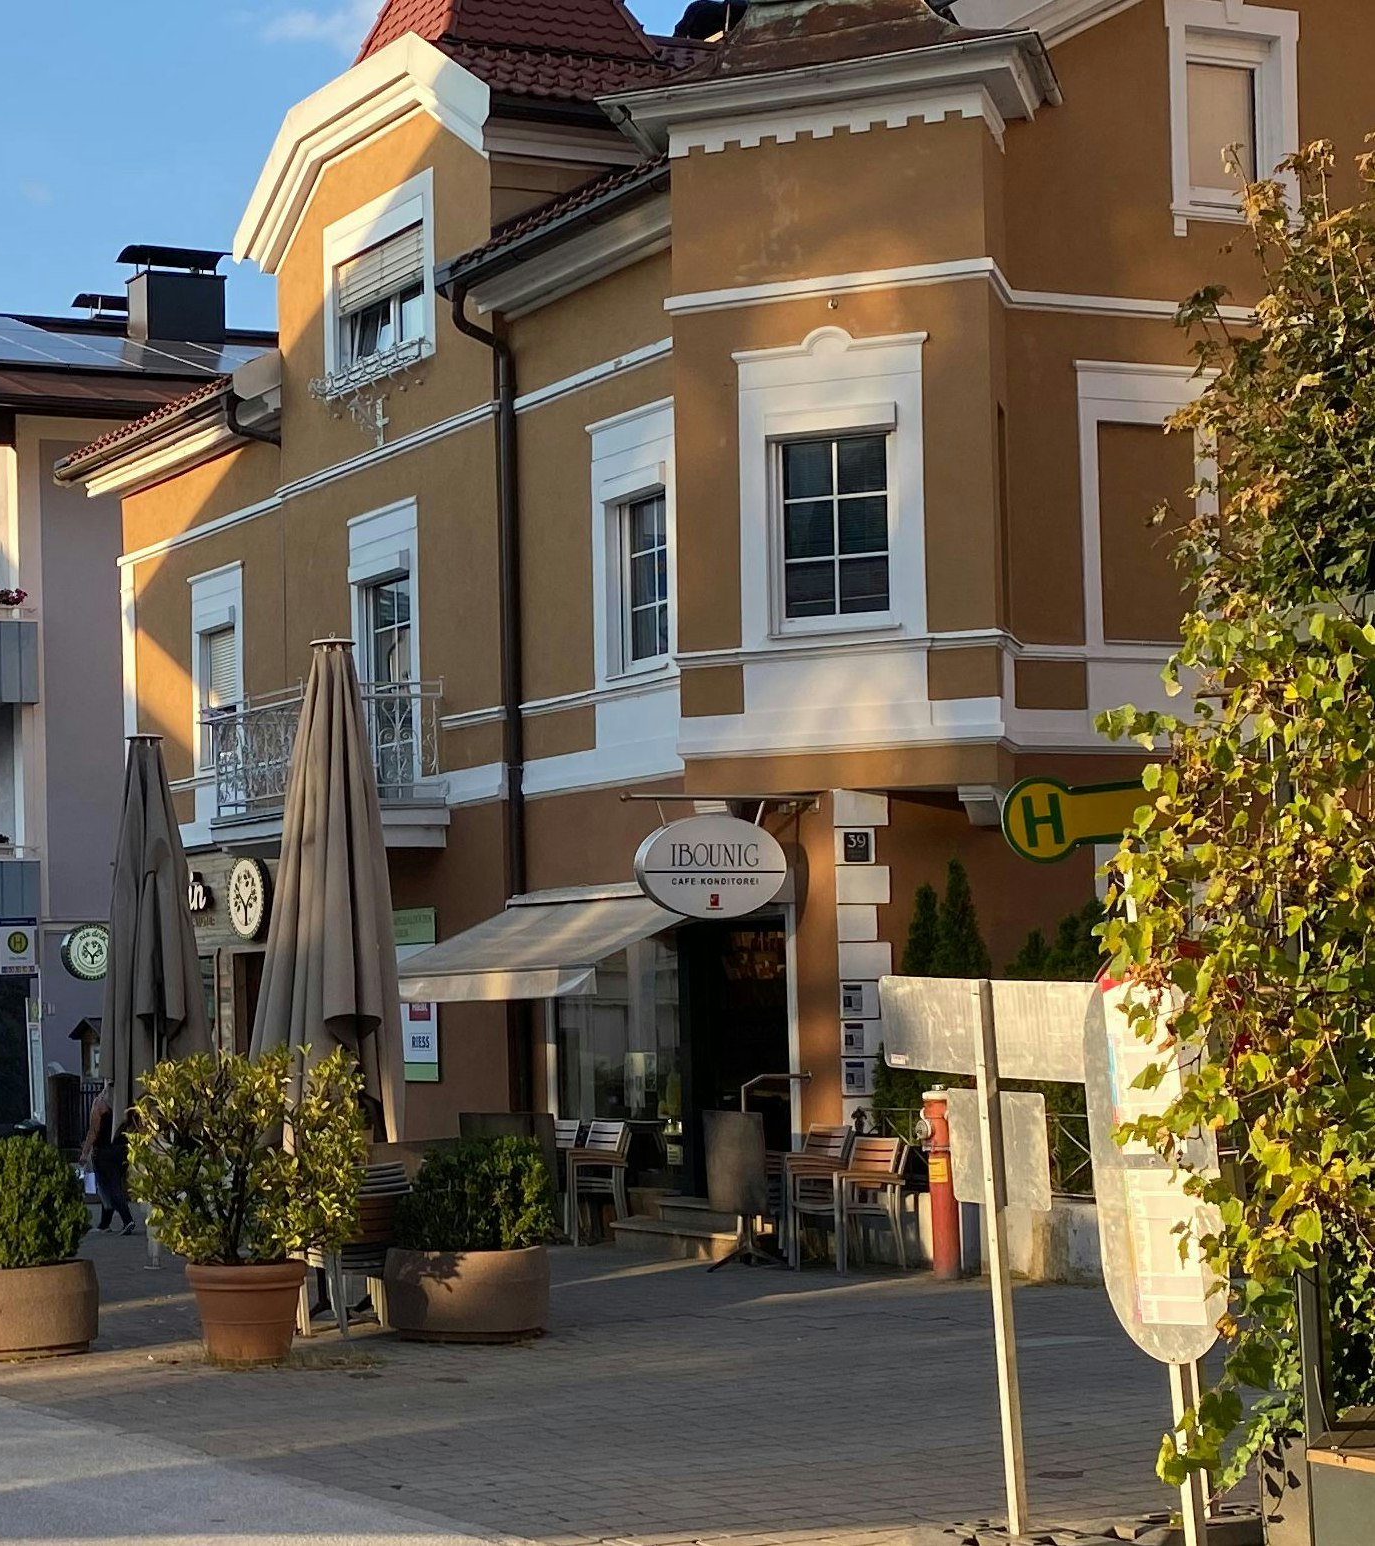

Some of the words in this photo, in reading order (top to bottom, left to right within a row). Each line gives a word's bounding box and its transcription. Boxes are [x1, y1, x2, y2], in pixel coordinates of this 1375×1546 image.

[1021, 792, 1065, 848] H
[847, 834, 866, 848] 39
[670, 842, 759, 868] IBOUNIG
[411, 1035, 430, 1048] RIESS
